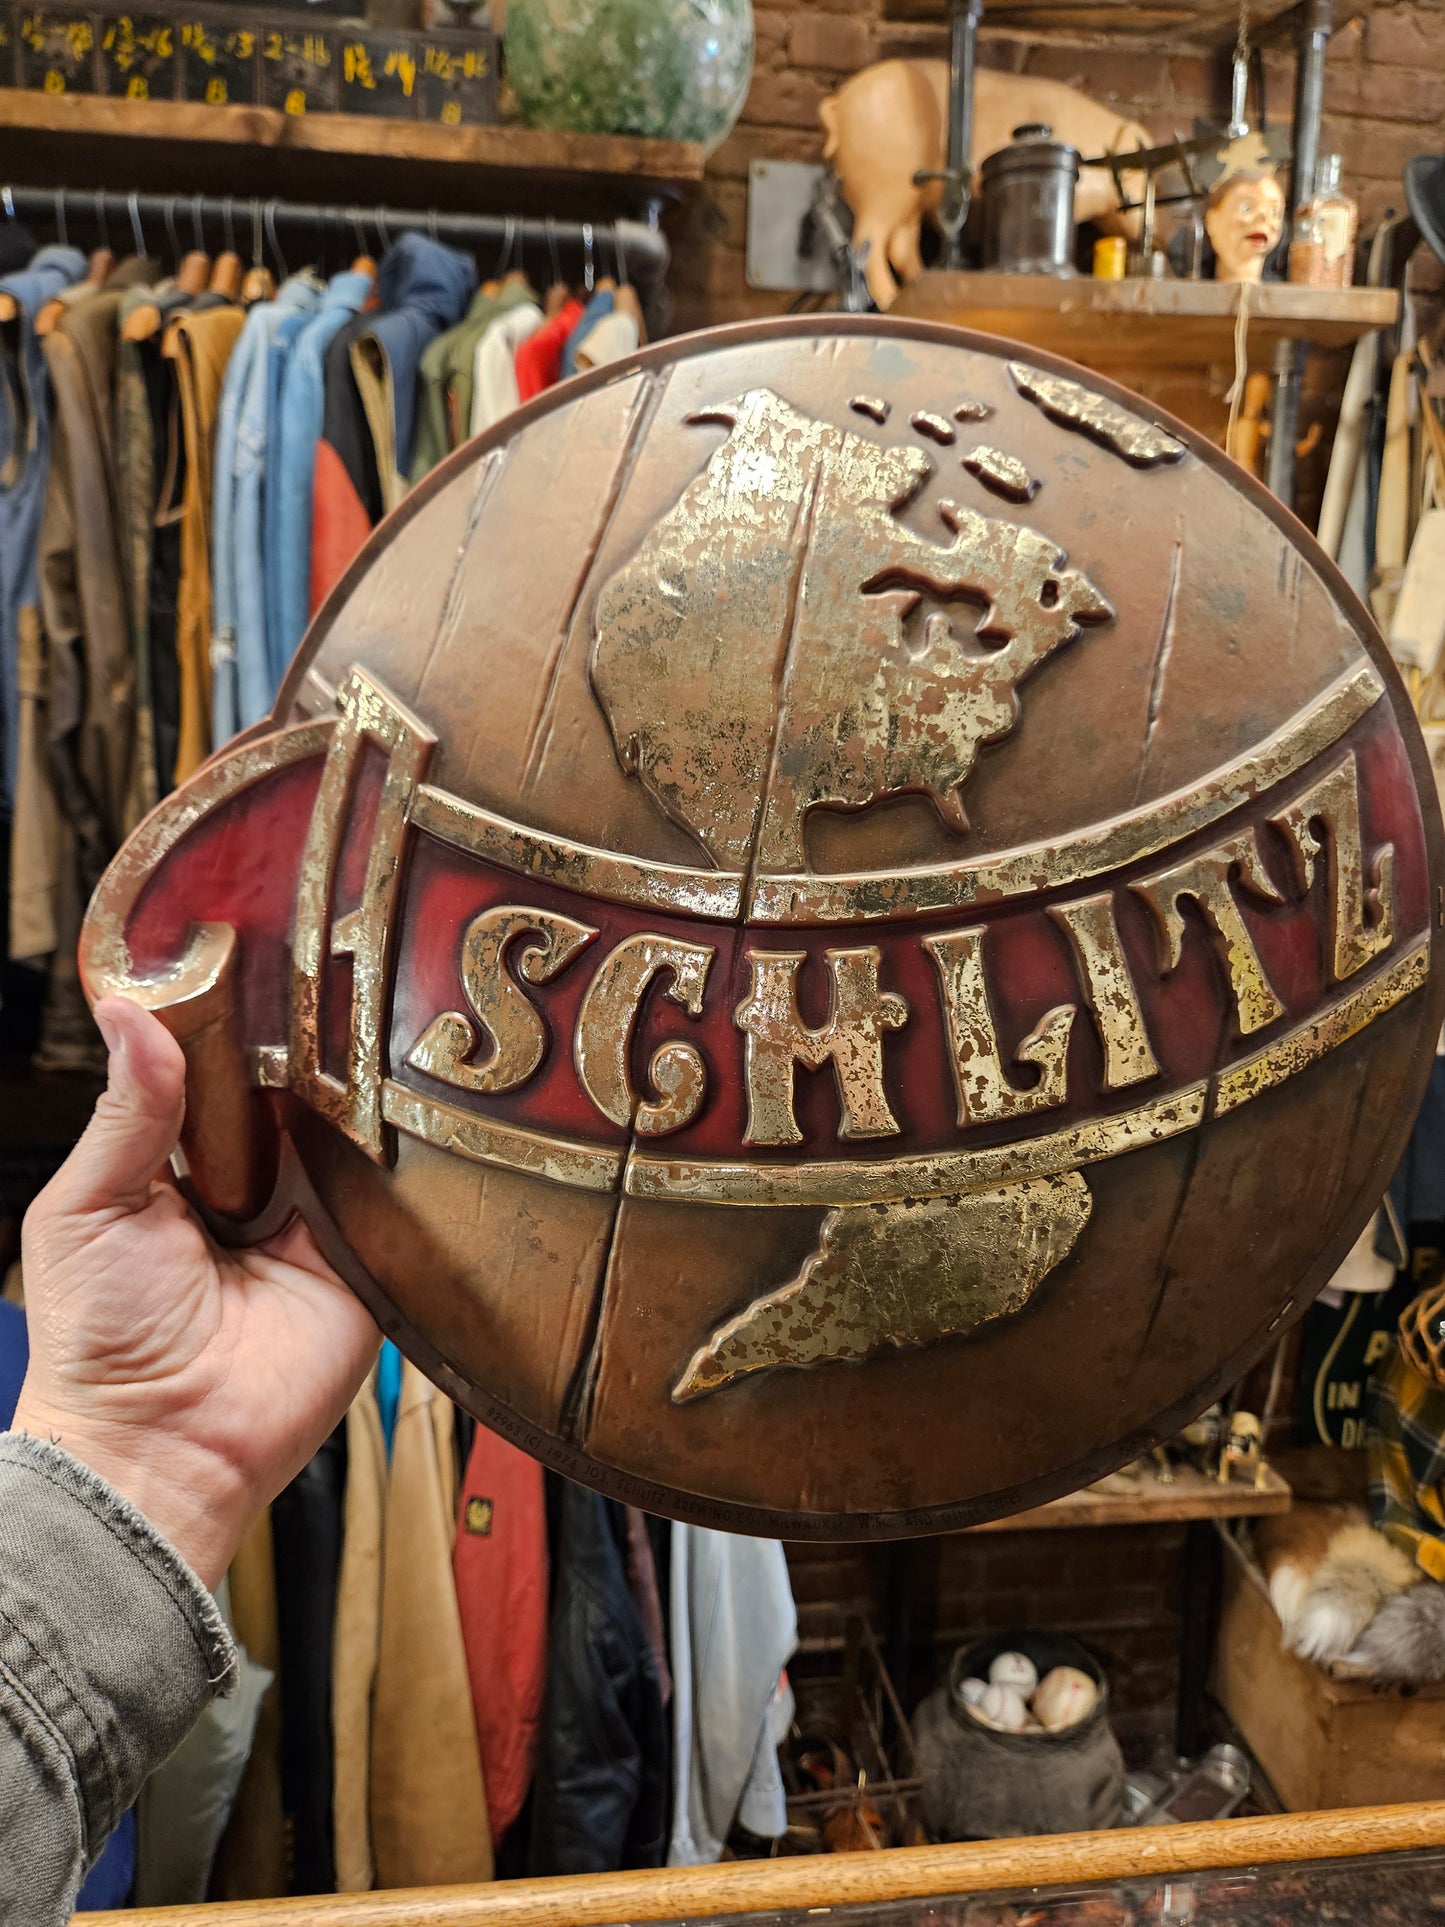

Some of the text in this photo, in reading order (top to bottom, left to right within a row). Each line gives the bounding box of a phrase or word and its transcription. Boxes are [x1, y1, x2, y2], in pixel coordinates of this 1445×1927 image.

[404, 750, 1394, 1146] SCHLITZ
[486, 1407, 521, 1436] 82963
[616, 1479, 666, 1506] SCHLITZ
[673, 1498, 732, 1522] BREWING
[904, 1512, 934, 1527] AND
